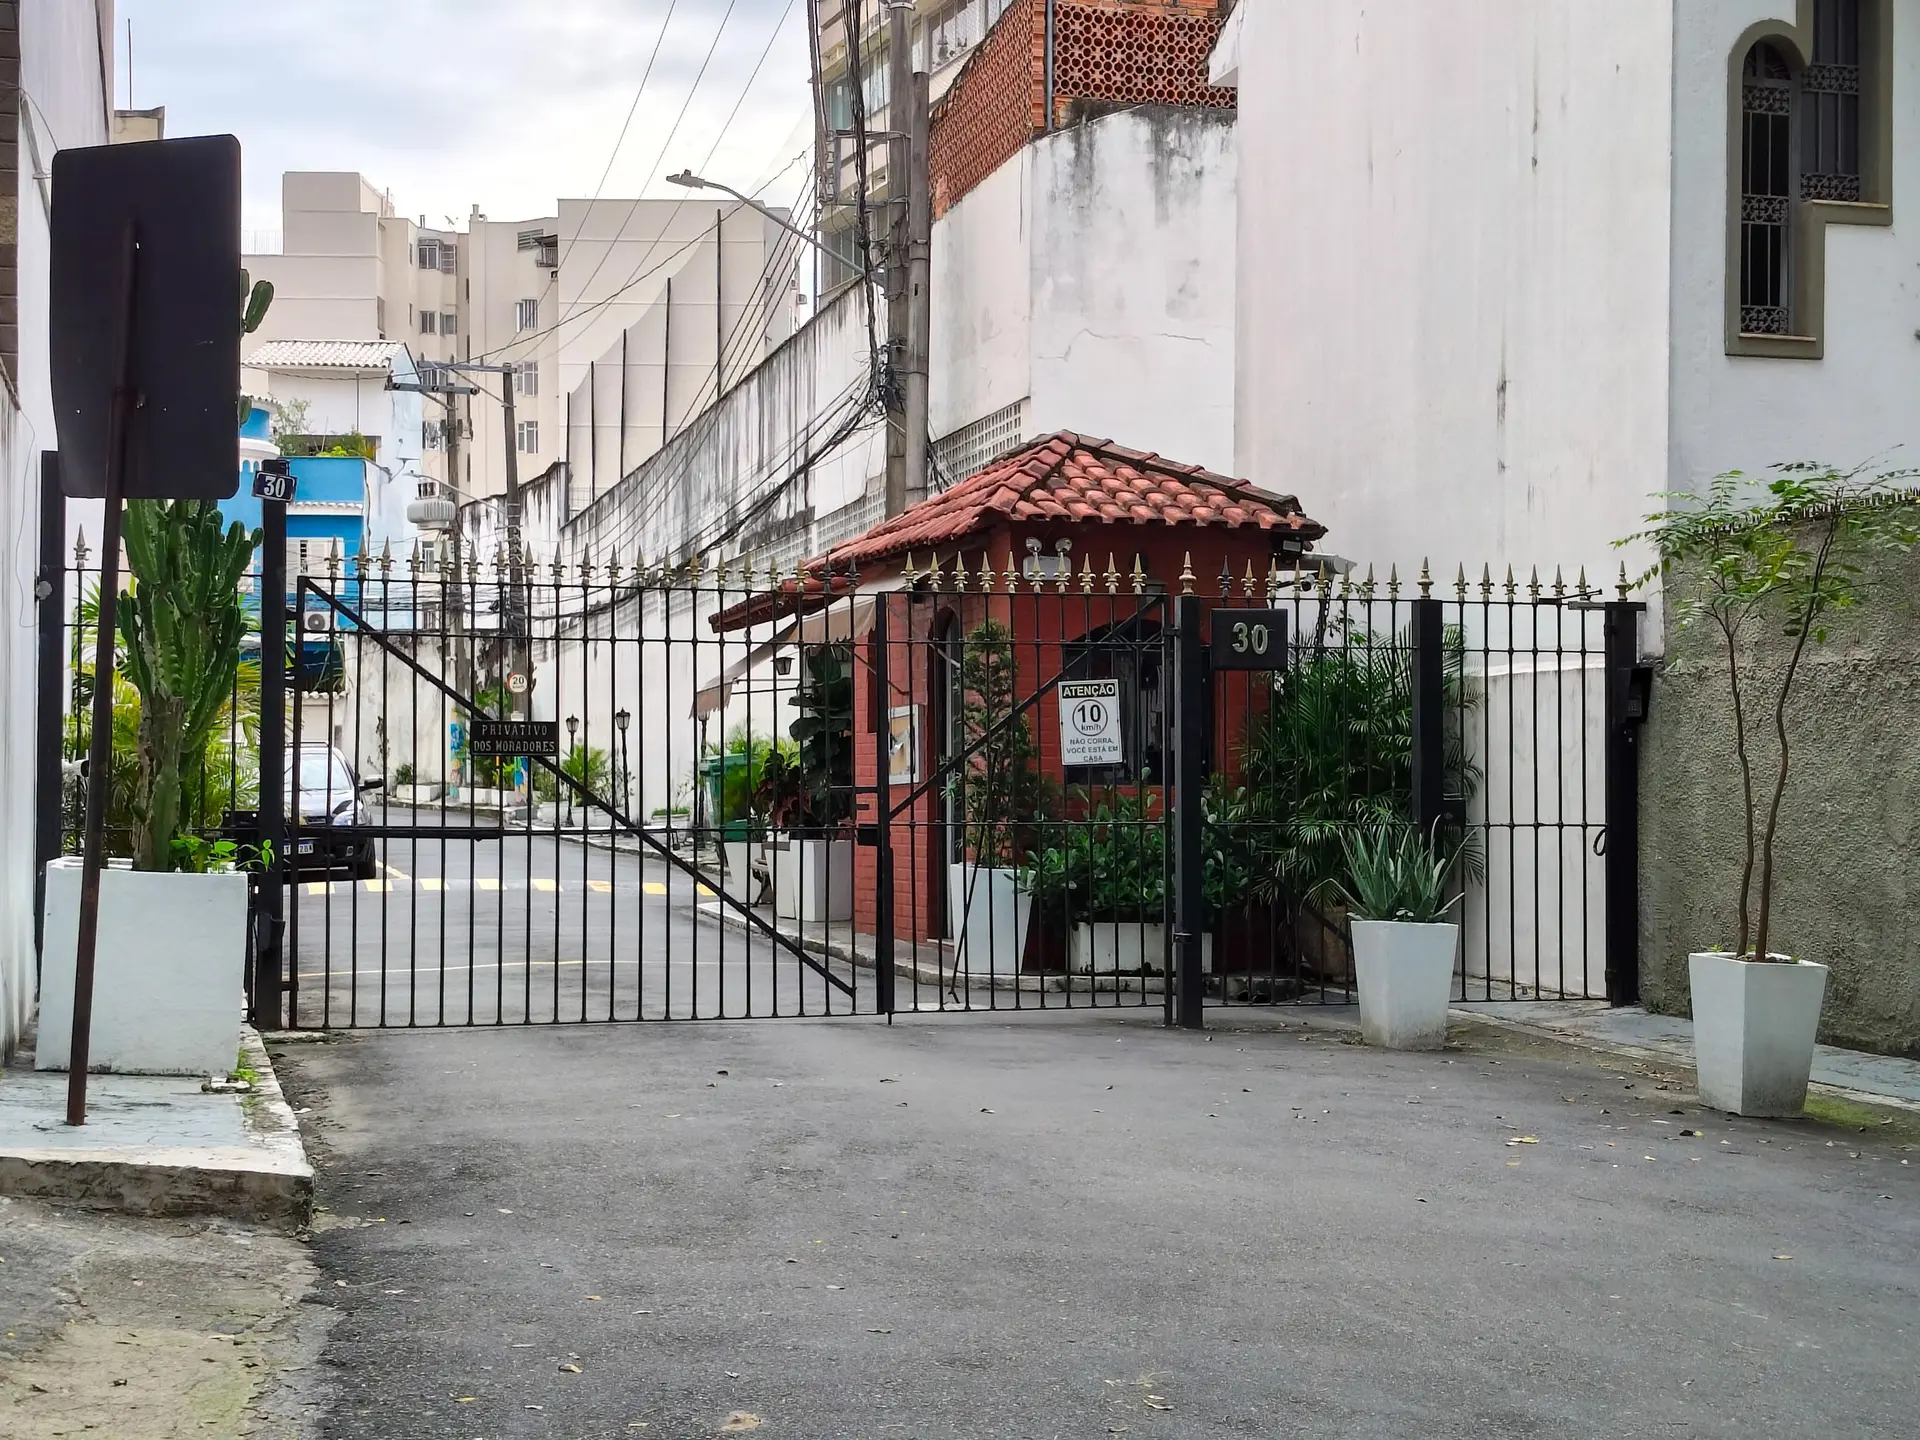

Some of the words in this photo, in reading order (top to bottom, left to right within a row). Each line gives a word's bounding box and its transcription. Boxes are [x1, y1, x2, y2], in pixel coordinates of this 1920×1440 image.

[263, 475, 286, 498] 30
[1232, 622, 1268, 655] 30
[512, 676, 525, 685] 20
[1063, 684, 1115, 697] ATENÇÃO
[1077, 704, 1101, 723] 10
[481, 724, 548, 736] PRIVATIVO
[473, 740, 492, 752] DOS
[495, 740, 556, 752] MORADORES
[1069, 737, 1086, 745] NÃO
[1066, 746, 1087, 754] VOCÊ
[1088, 745, 1107, 753] ESTÁ
[1083, 755, 1104, 763] CASA
